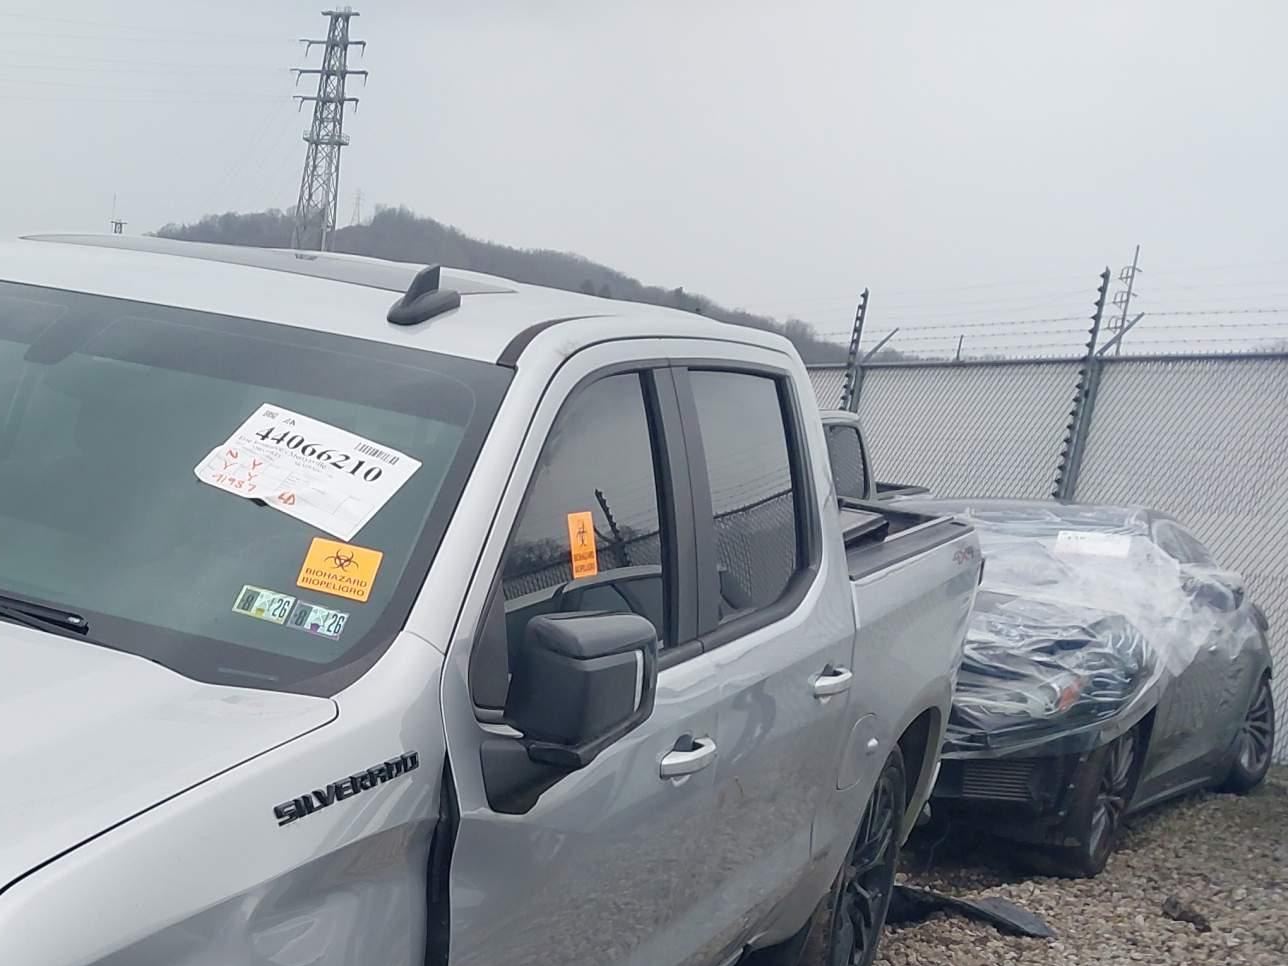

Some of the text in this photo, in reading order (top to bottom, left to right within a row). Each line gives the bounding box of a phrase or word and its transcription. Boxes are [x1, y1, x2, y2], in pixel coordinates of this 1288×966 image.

[255, 425, 383, 483] 44066210
[300, 575, 366, 598] BIOPELIGRO
[304, 566, 368, 589] BIOHAZARD
[271, 597, 291, 619] 26
[326, 612, 346, 635] 26
[272, 749, 420, 827] SILVERADO
